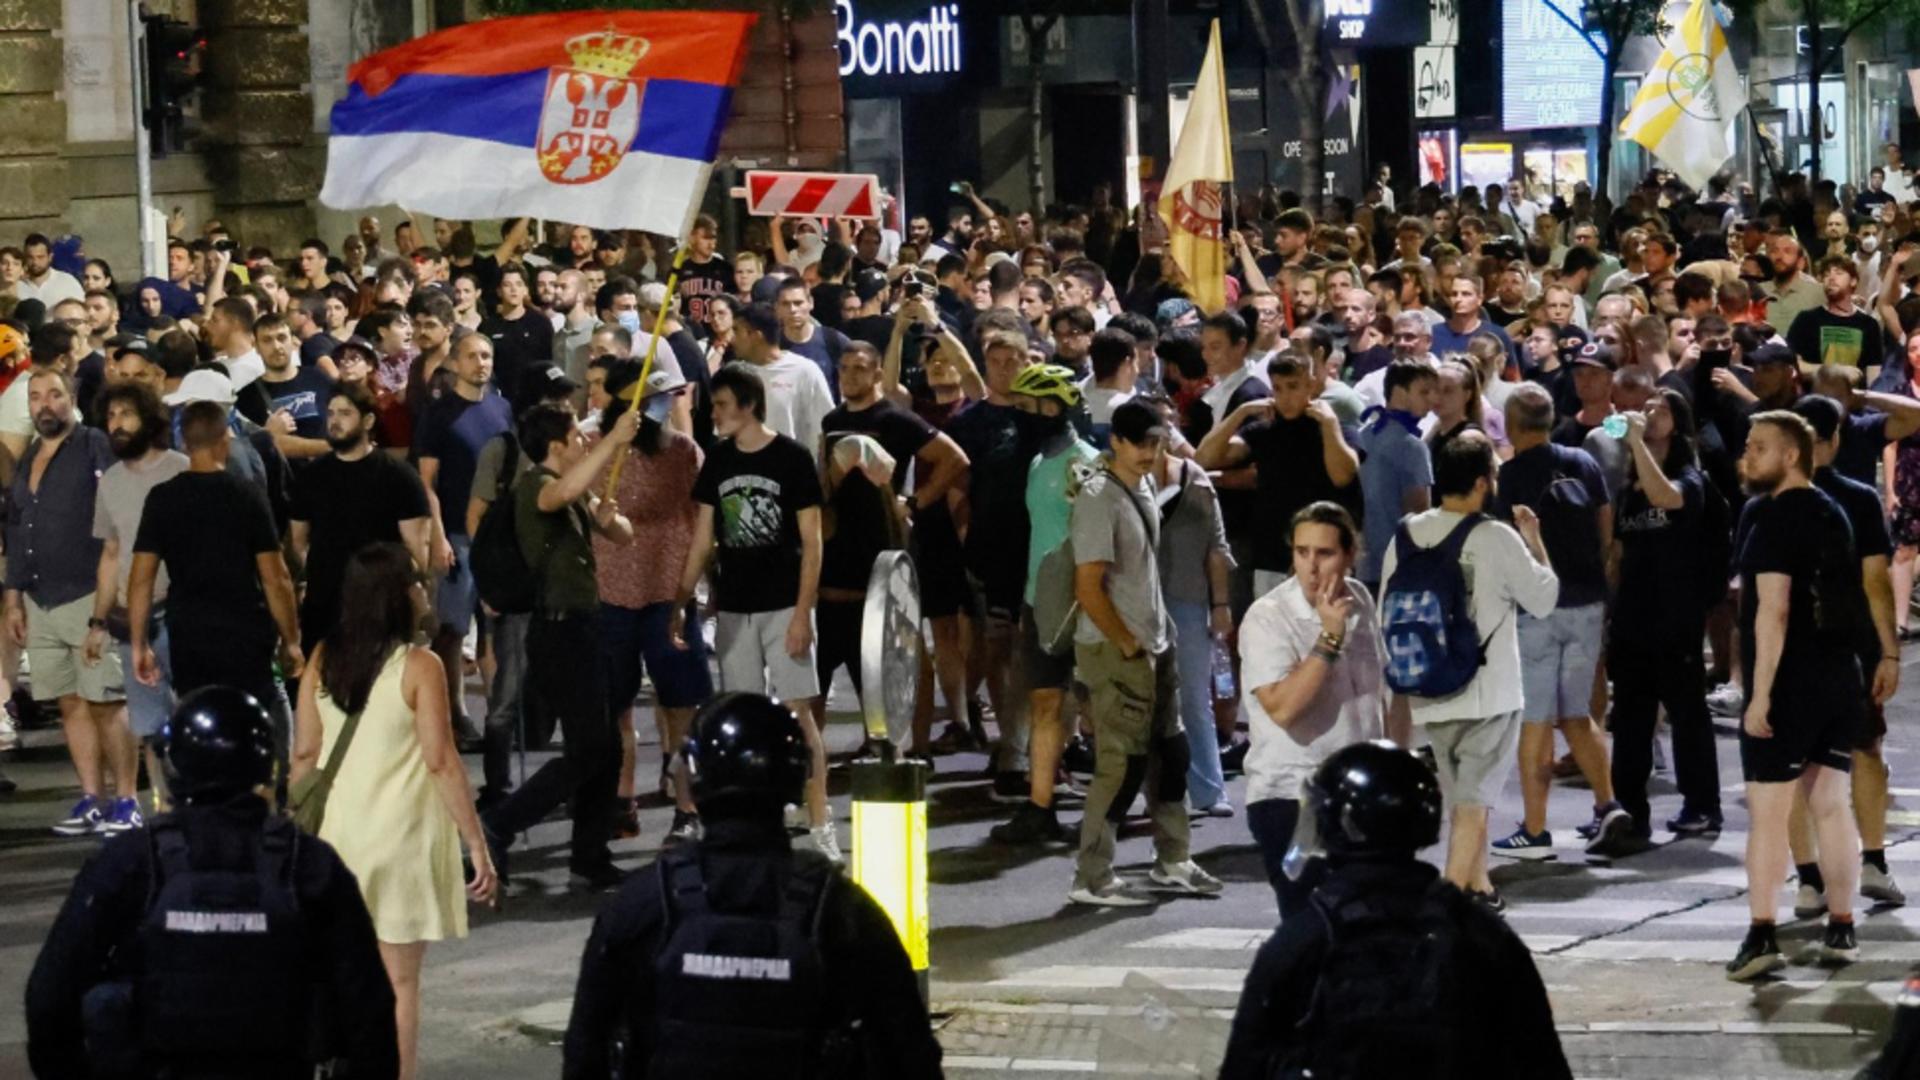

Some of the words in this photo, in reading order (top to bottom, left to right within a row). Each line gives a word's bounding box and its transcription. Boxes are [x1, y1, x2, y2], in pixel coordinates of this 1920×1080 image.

[836, 0, 960, 76] Bonatti
[1010, 14, 1066, 51] BM
[1338, 20, 1365, 39] SHOP
[1283, 140, 1301, 158] OPE
[1323, 138, 1349, 156] SOON
